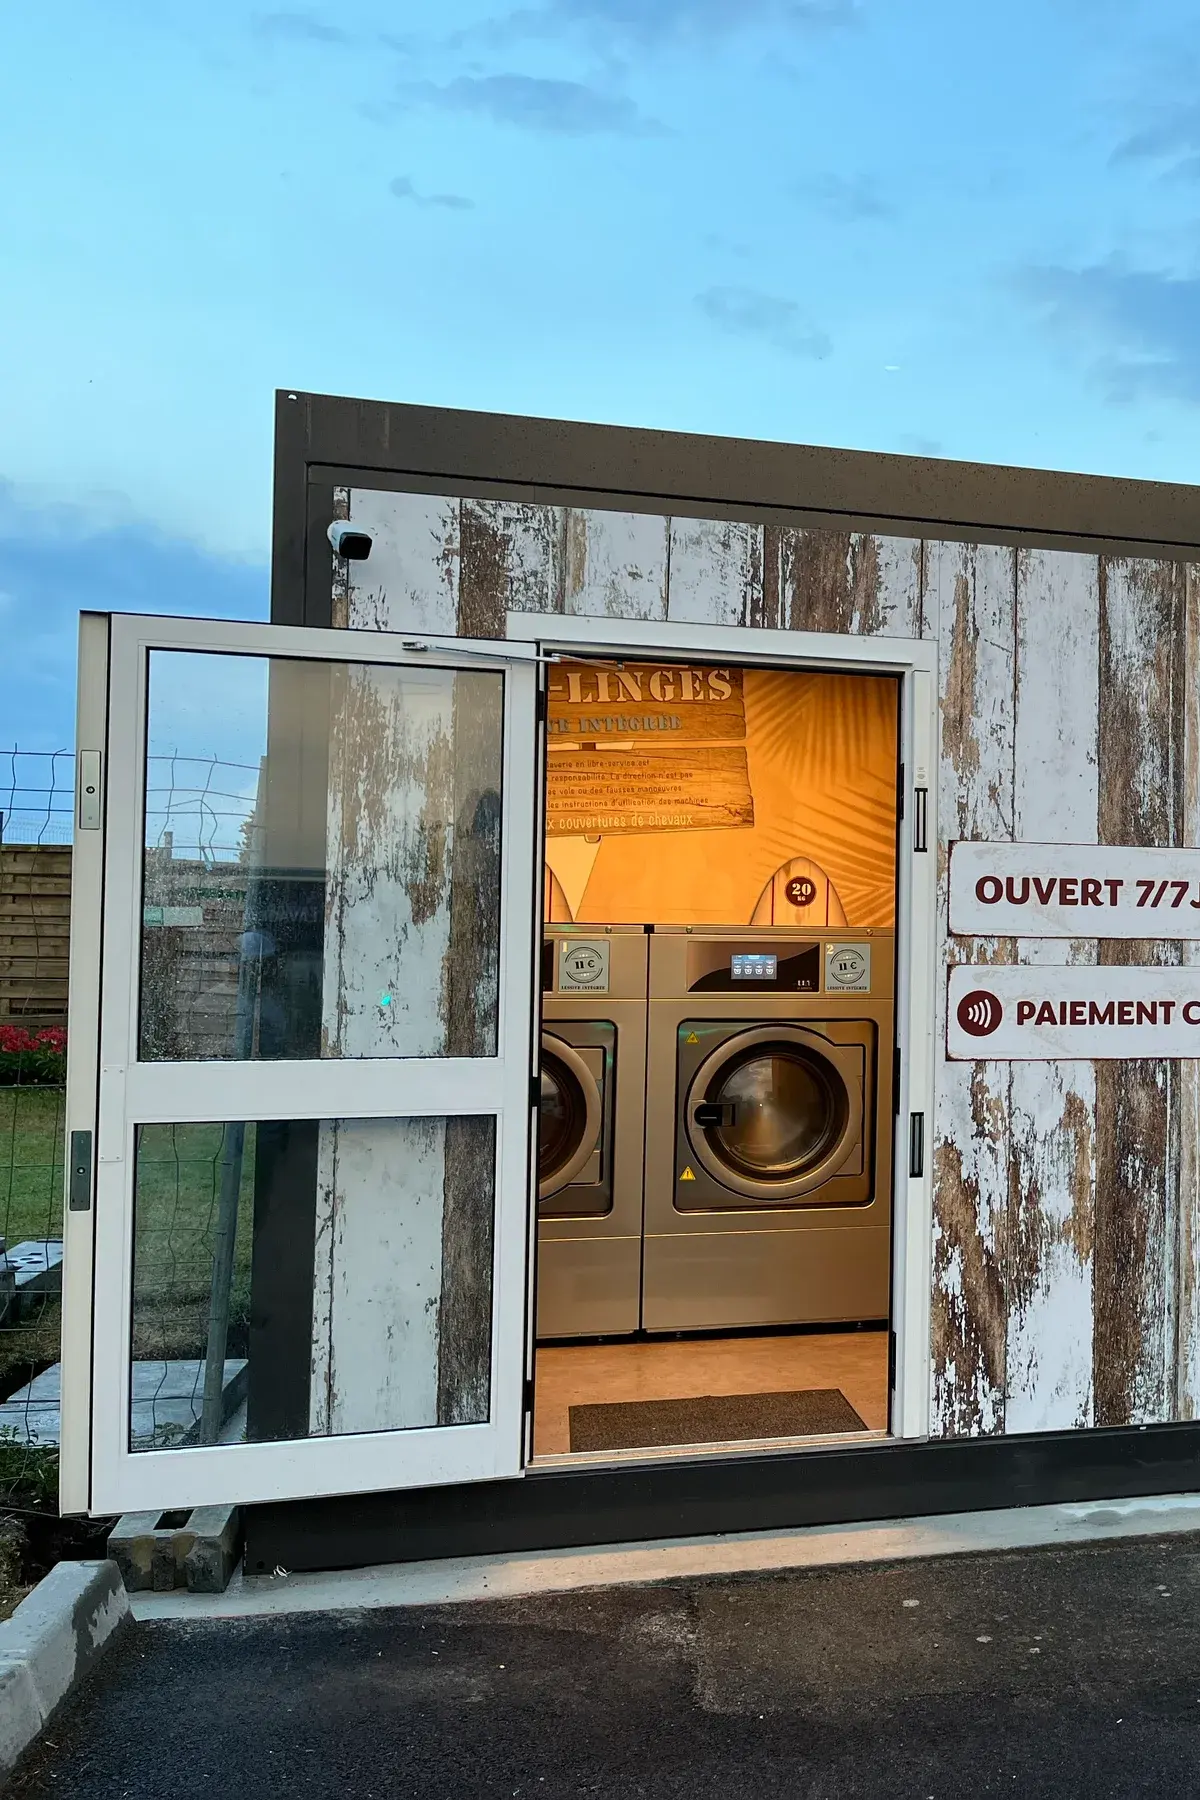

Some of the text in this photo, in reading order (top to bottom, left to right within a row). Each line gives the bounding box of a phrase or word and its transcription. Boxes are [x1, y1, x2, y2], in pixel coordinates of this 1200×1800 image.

[576, 760, 585, 768] en
[680, 772, 693, 781] pas
[590, 786, 603, 794] des
[606, 786, 635, 794] fausses
[562, 800, 608, 808] instructions
[559, 814, 626, 830] couvertures
[631, 812, 644, 827] de
[649, 812, 693, 827] chevaux
[791, 882, 812, 895] 20
[975, 875, 1124, 907] OUVERT
[563, 942, 568, 953] 1
[826, 944, 835, 955] 2
[1016, 1000, 1176, 1026] PAIEMENT
